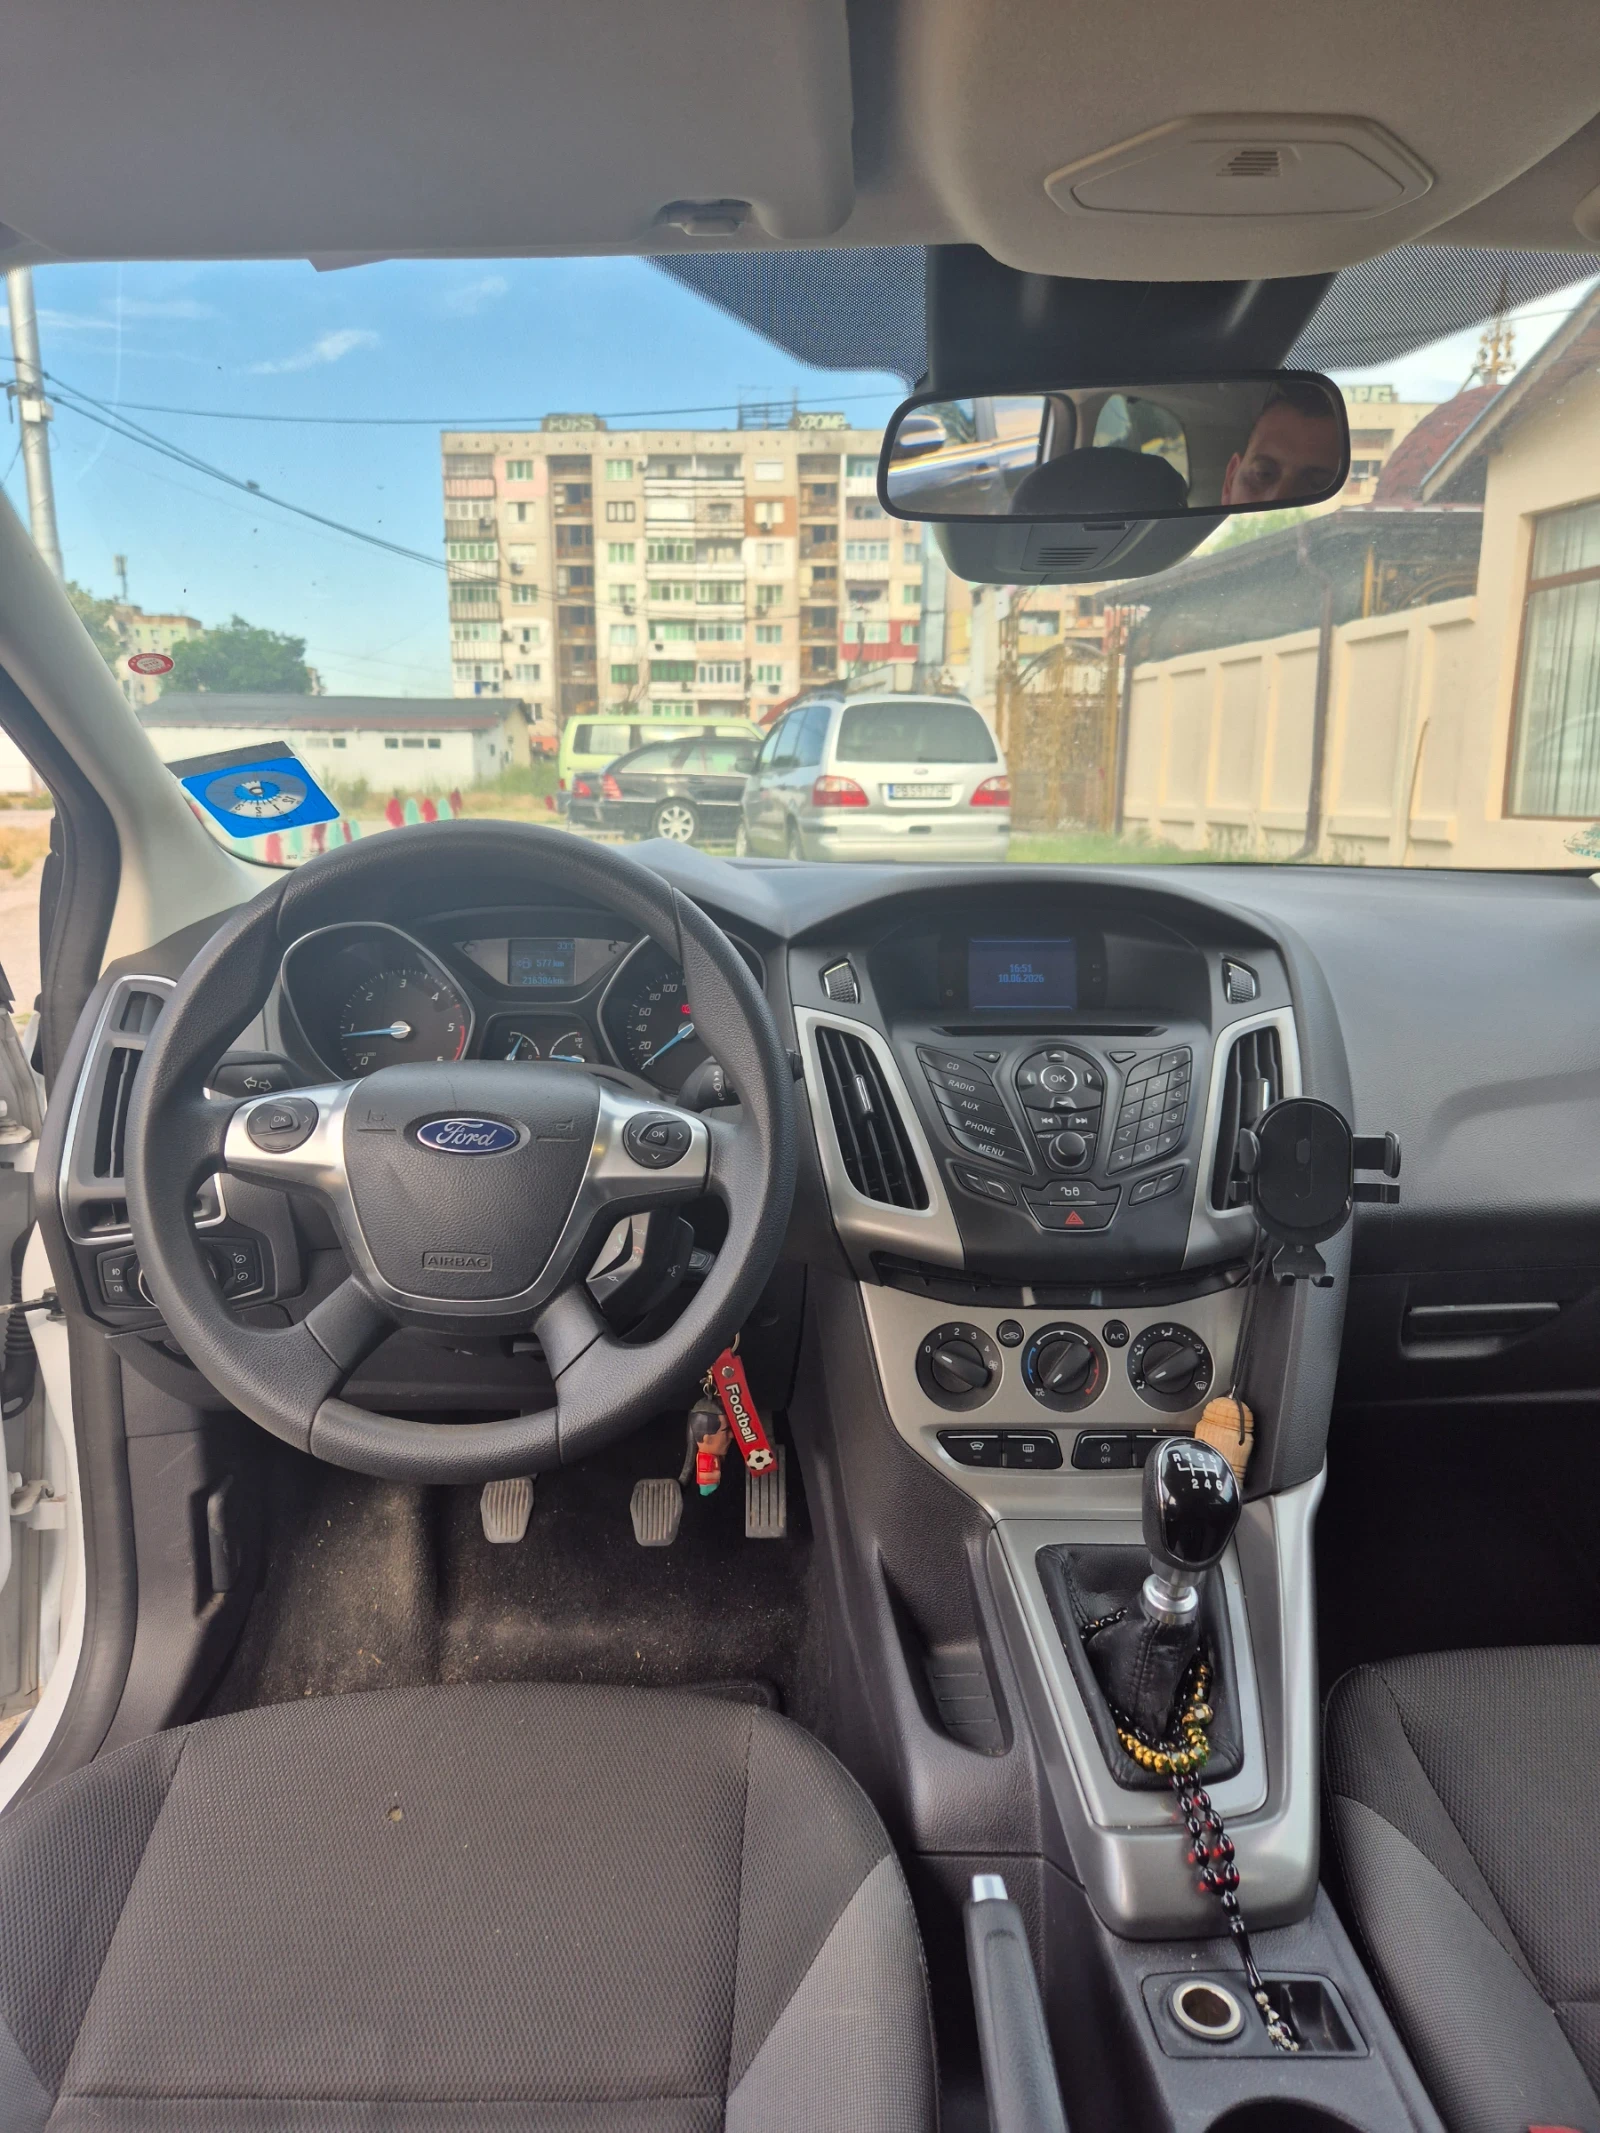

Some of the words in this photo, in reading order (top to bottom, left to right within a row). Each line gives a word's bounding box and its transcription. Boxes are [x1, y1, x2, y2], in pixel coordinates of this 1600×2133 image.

[536, 959, 551, 968] 577
[399, 979, 407, 988] 3
[662, 984, 678, 993] 100
[365, 992, 374, 1001] 2
[431, 992, 439, 1001] 4
[649, 993, 661, 1001] 80
[638, 1007, 652, 1017] 60
[447, 1022, 455, 1032] 5
[635, 1024, 648, 1032] 40
[638, 1041, 652, 1050] 20
[360, 1056, 369, 1066] 0
[946, 1061, 960, 1071] CD
[1050, 1074, 1068, 1083] OK
[947, 1079, 976, 1092] RADIO
[960, 1100, 981, 1112] AUX
[273, 1115, 287, 1123] OK
[964, 1119, 997, 1136] PHONE
[1148, 1122, 1155, 1130] 8
[435, 1121, 498, 1147] Ford
[651, 1130, 666, 1139] OK
[978, 1142, 1006, 1158] MENU
[427, 1255, 489, 1268] AIRBAG
[937, 1332, 943, 1340] 1
[954, 1327, 960, 1336] 2
[970, 1331, 977, 1340] 3
[1110, 1333, 1125, 1341] A/C
[925, 1345, 931, 1354] 0
[984, 1345, 991, 1353] 4
[725, 1383, 758, 1443] Football
[1172, 1453, 1182, 1462] R
[1184, 1452, 1192, 1461] 1
[1196, 1452, 1205, 1461] 3
[1208, 1454, 1217, 1463] 5
[1191, 1478, 1200, 1489] 2
[1203, 1478, 1213, 1490] 4
[1215, 1480, 1223, 1491] 6
